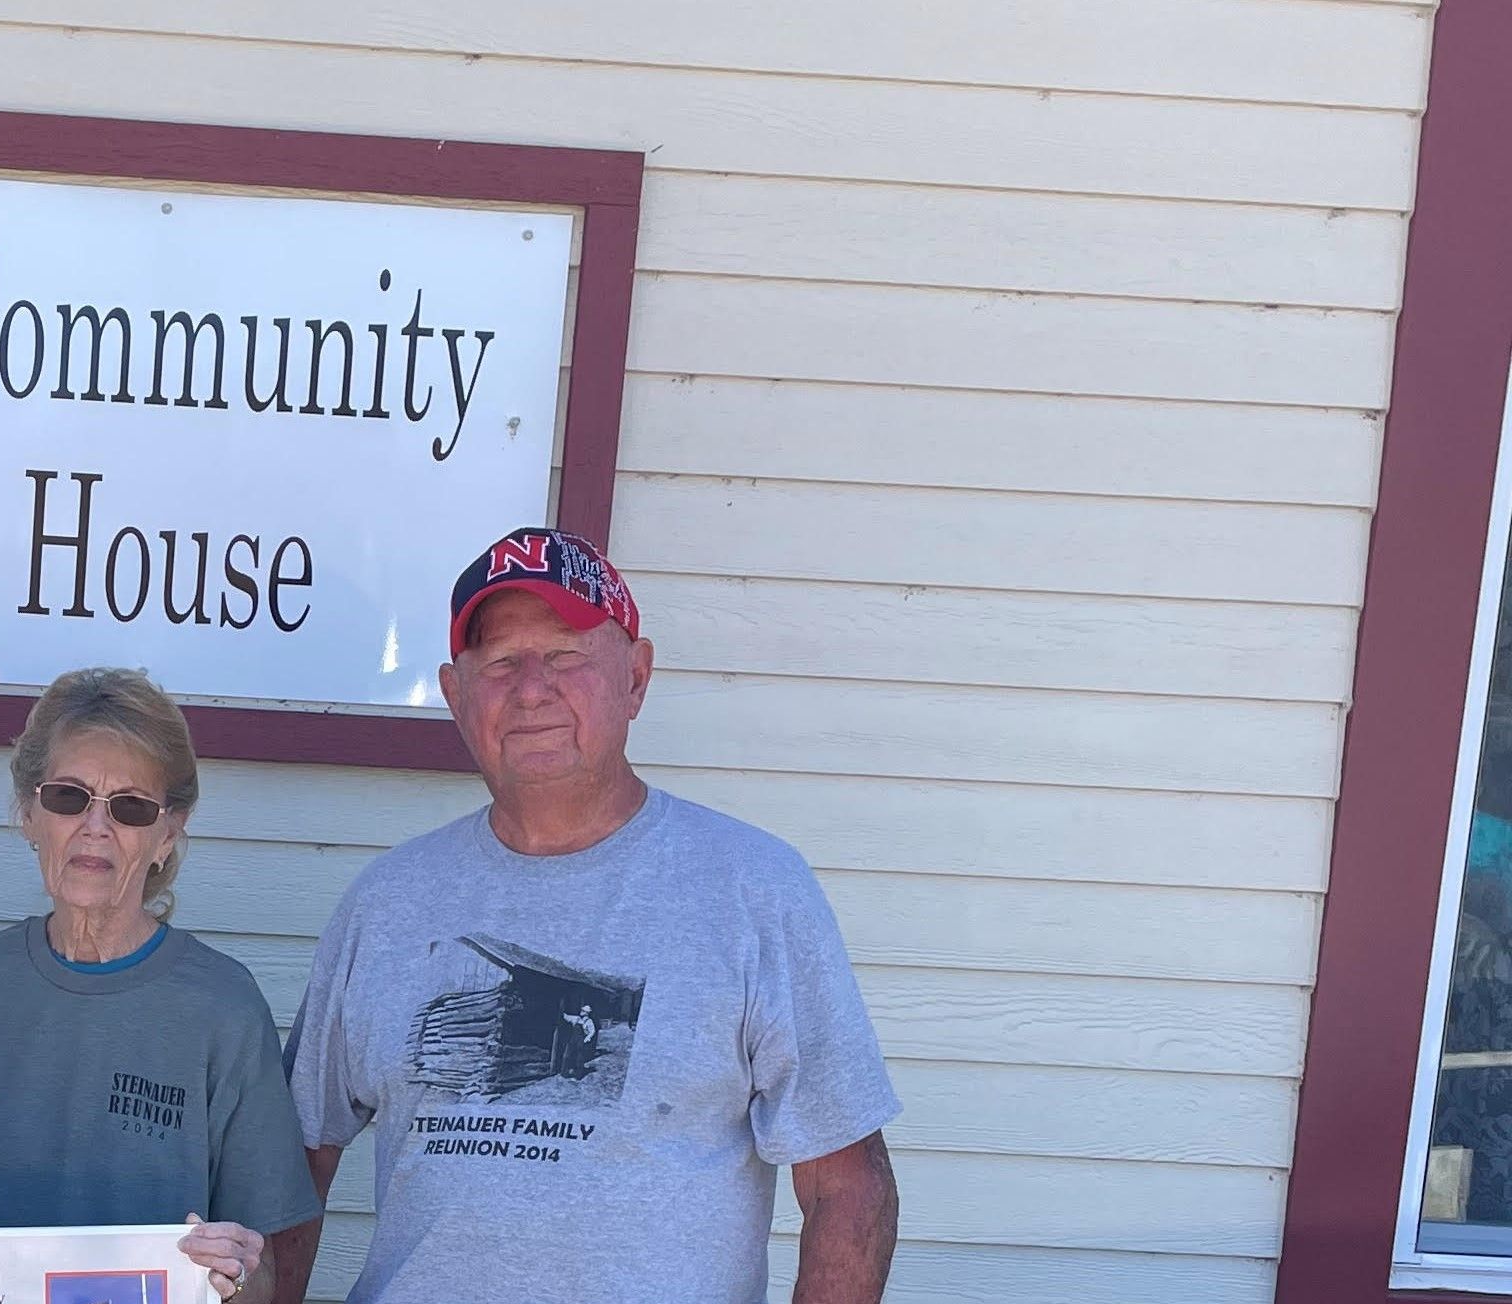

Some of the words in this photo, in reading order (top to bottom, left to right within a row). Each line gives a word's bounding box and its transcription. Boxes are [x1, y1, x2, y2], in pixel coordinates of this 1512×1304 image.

[18, 468, 314, 633] House
[487, 535, 551, 582] N
[112, 1072, 186, 1107] STEINAUER
[108, 1094, 184, 1130] REUNION
[512, 1118, 595, 1141] FAMILY
[122, 1120, 165, 1141] 2024
[423, 1139, 510, 1156] REUNION
[514, 1144, 560, 1162] 2014
